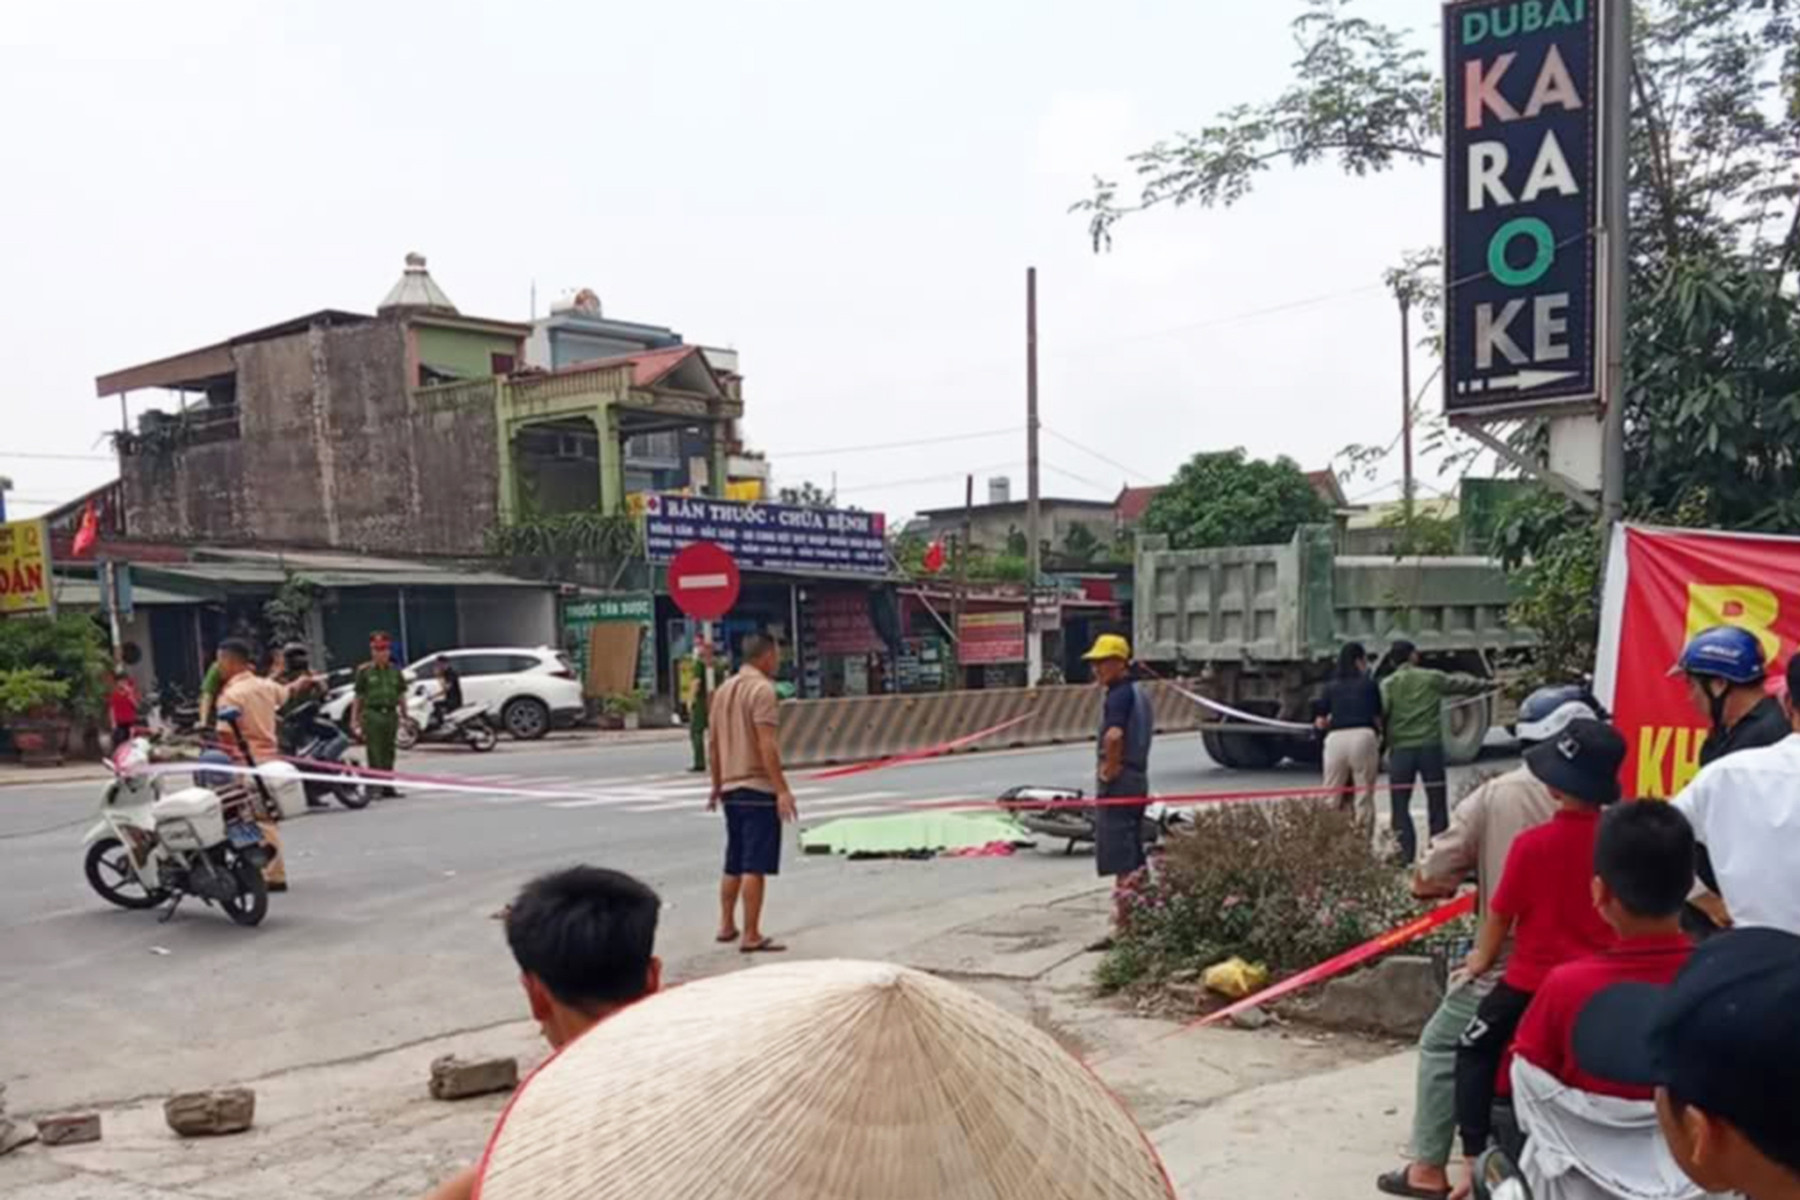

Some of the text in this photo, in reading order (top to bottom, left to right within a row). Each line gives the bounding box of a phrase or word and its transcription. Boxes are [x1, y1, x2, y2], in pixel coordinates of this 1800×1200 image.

[1462, 0, 1585, 45] DUBAI
[1464, 43, 1582, 129] KA
[1468, 129, 1579, 211] RA
[1488, 217, 1555, 286] O
[1475, 293, 1569, 369] KE
[709, 500, 767, 524] THUỐC
[779, 508, 824, 528] CHỮA
[827, 513, 869, 533] BỆNH
